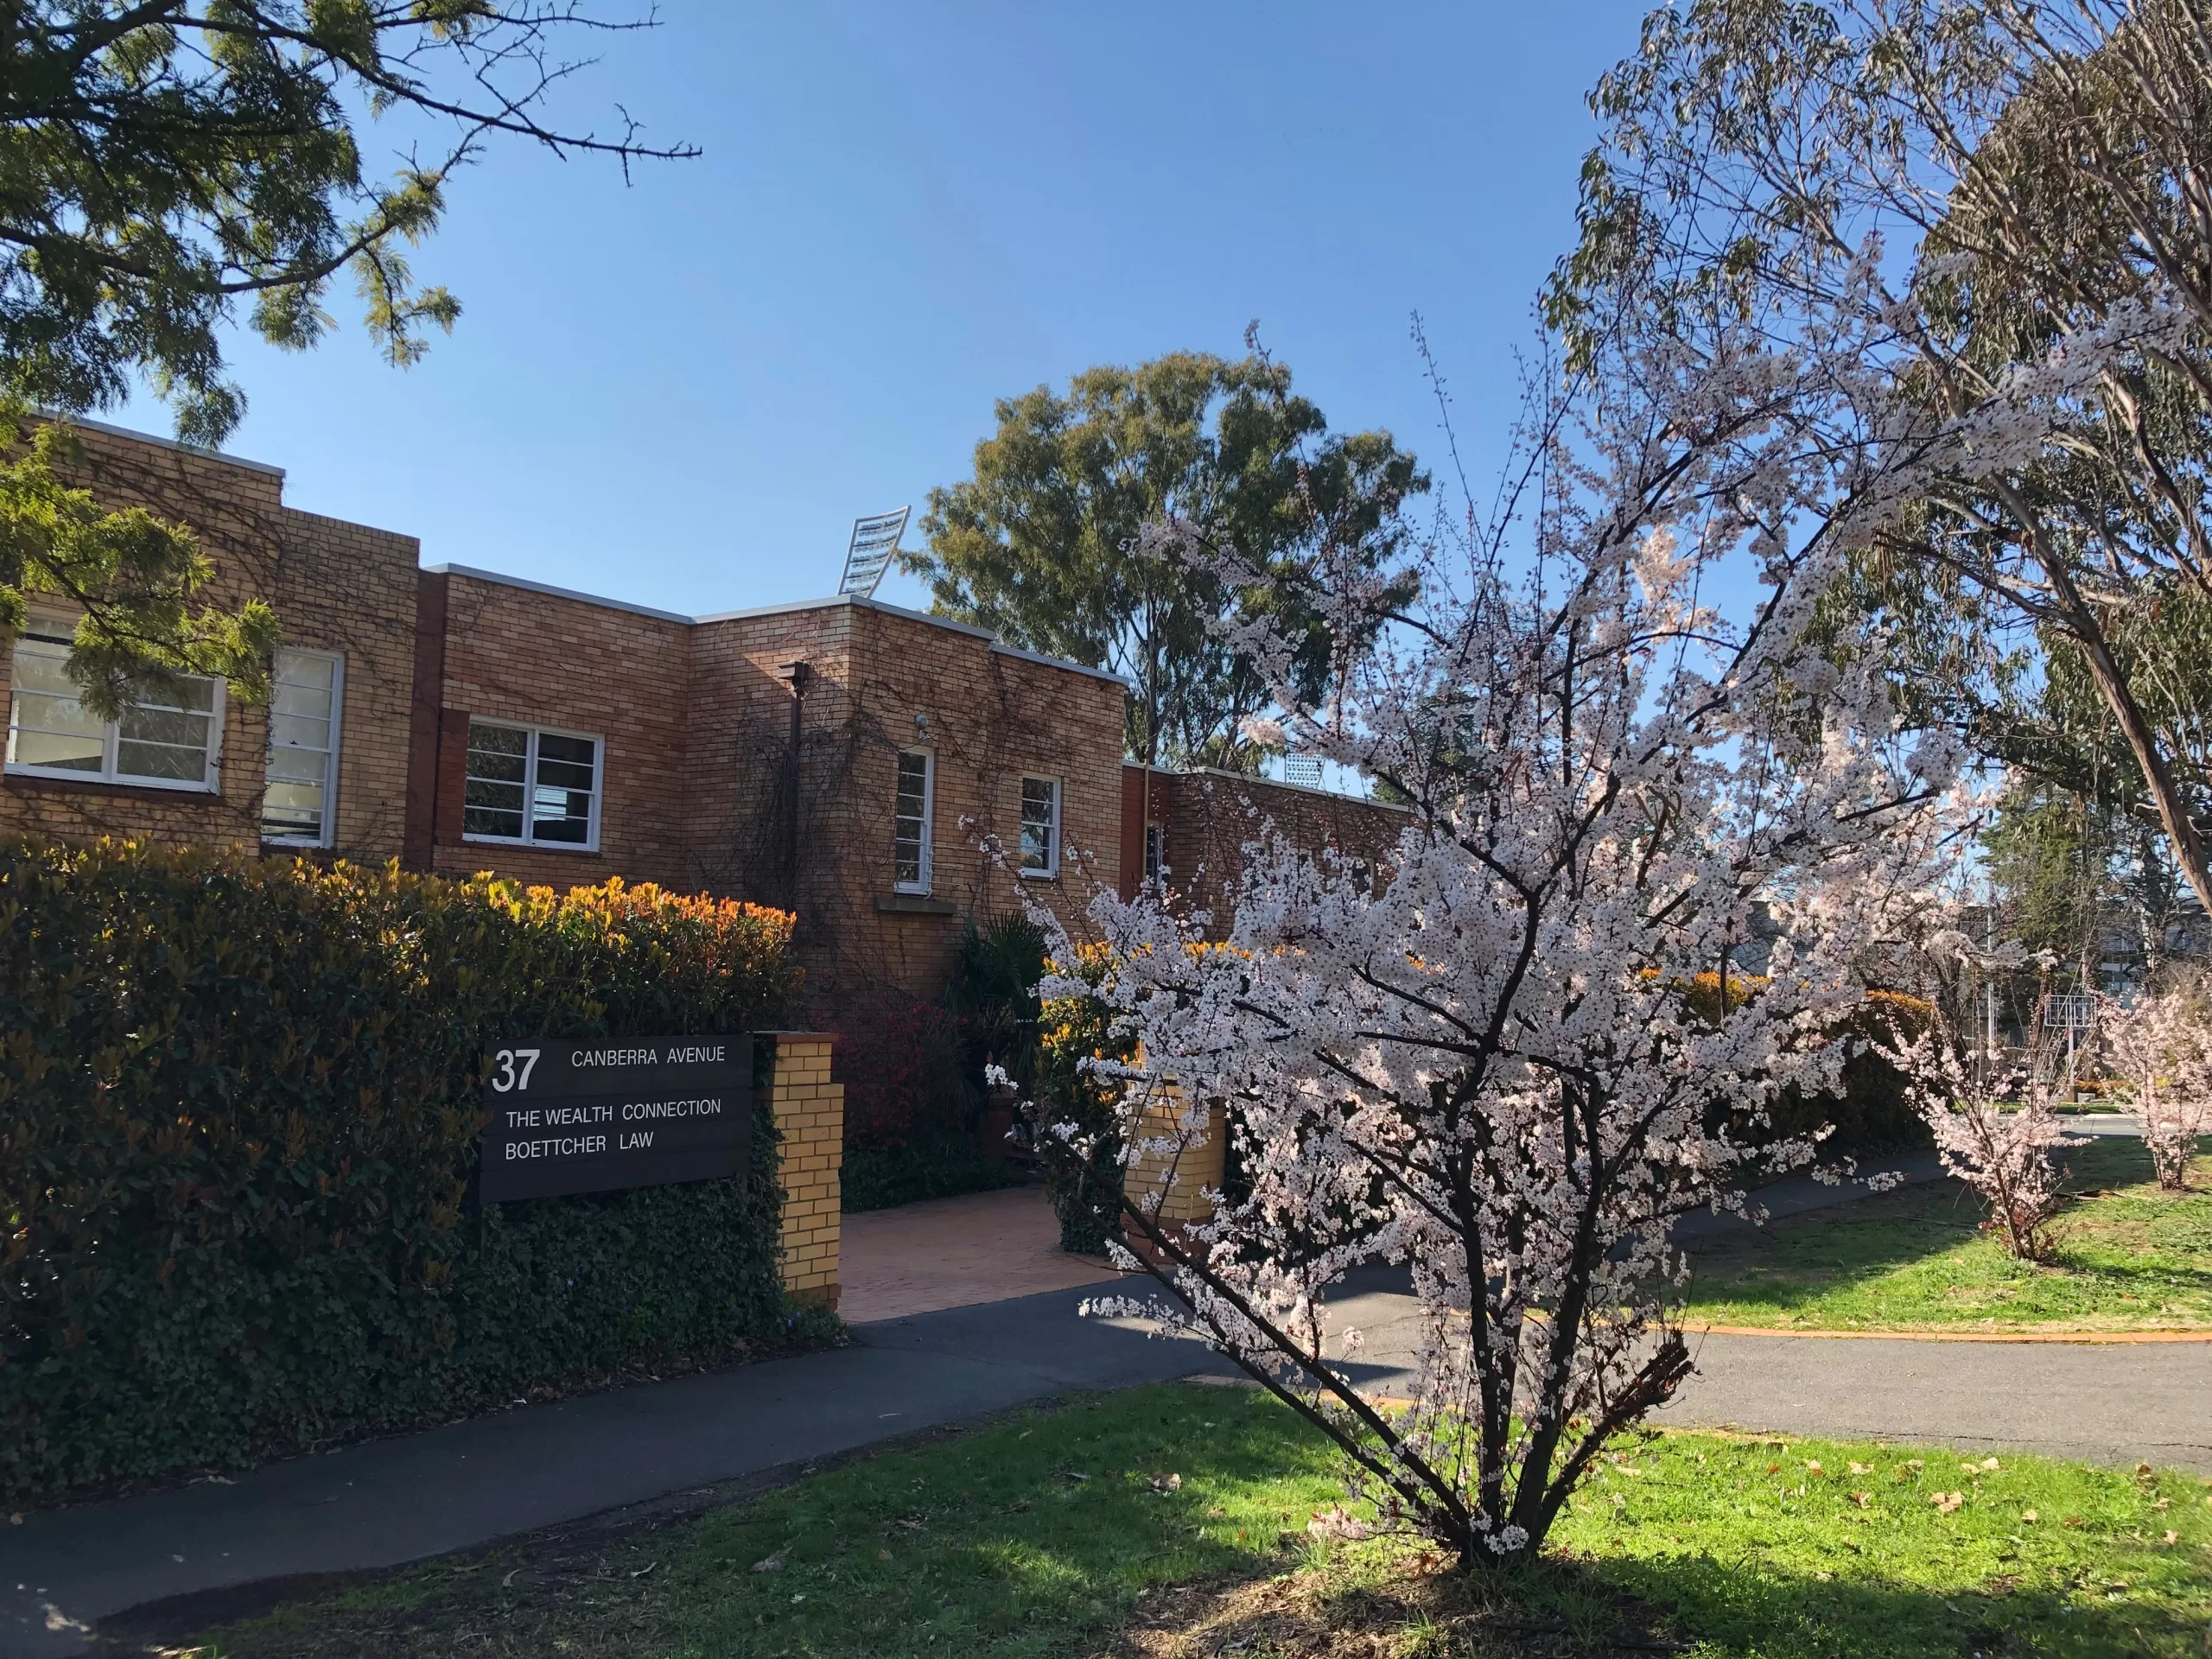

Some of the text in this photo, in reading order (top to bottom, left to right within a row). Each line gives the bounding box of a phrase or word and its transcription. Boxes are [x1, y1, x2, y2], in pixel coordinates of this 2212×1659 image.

[492, 1046, 725, 1093] 37 CANBERRA AVENUE
[506, 1098, 721, 1128] THE WEALTH CONNECTION
[505, 1131, 653, 1160] BOETTCHER LAW
